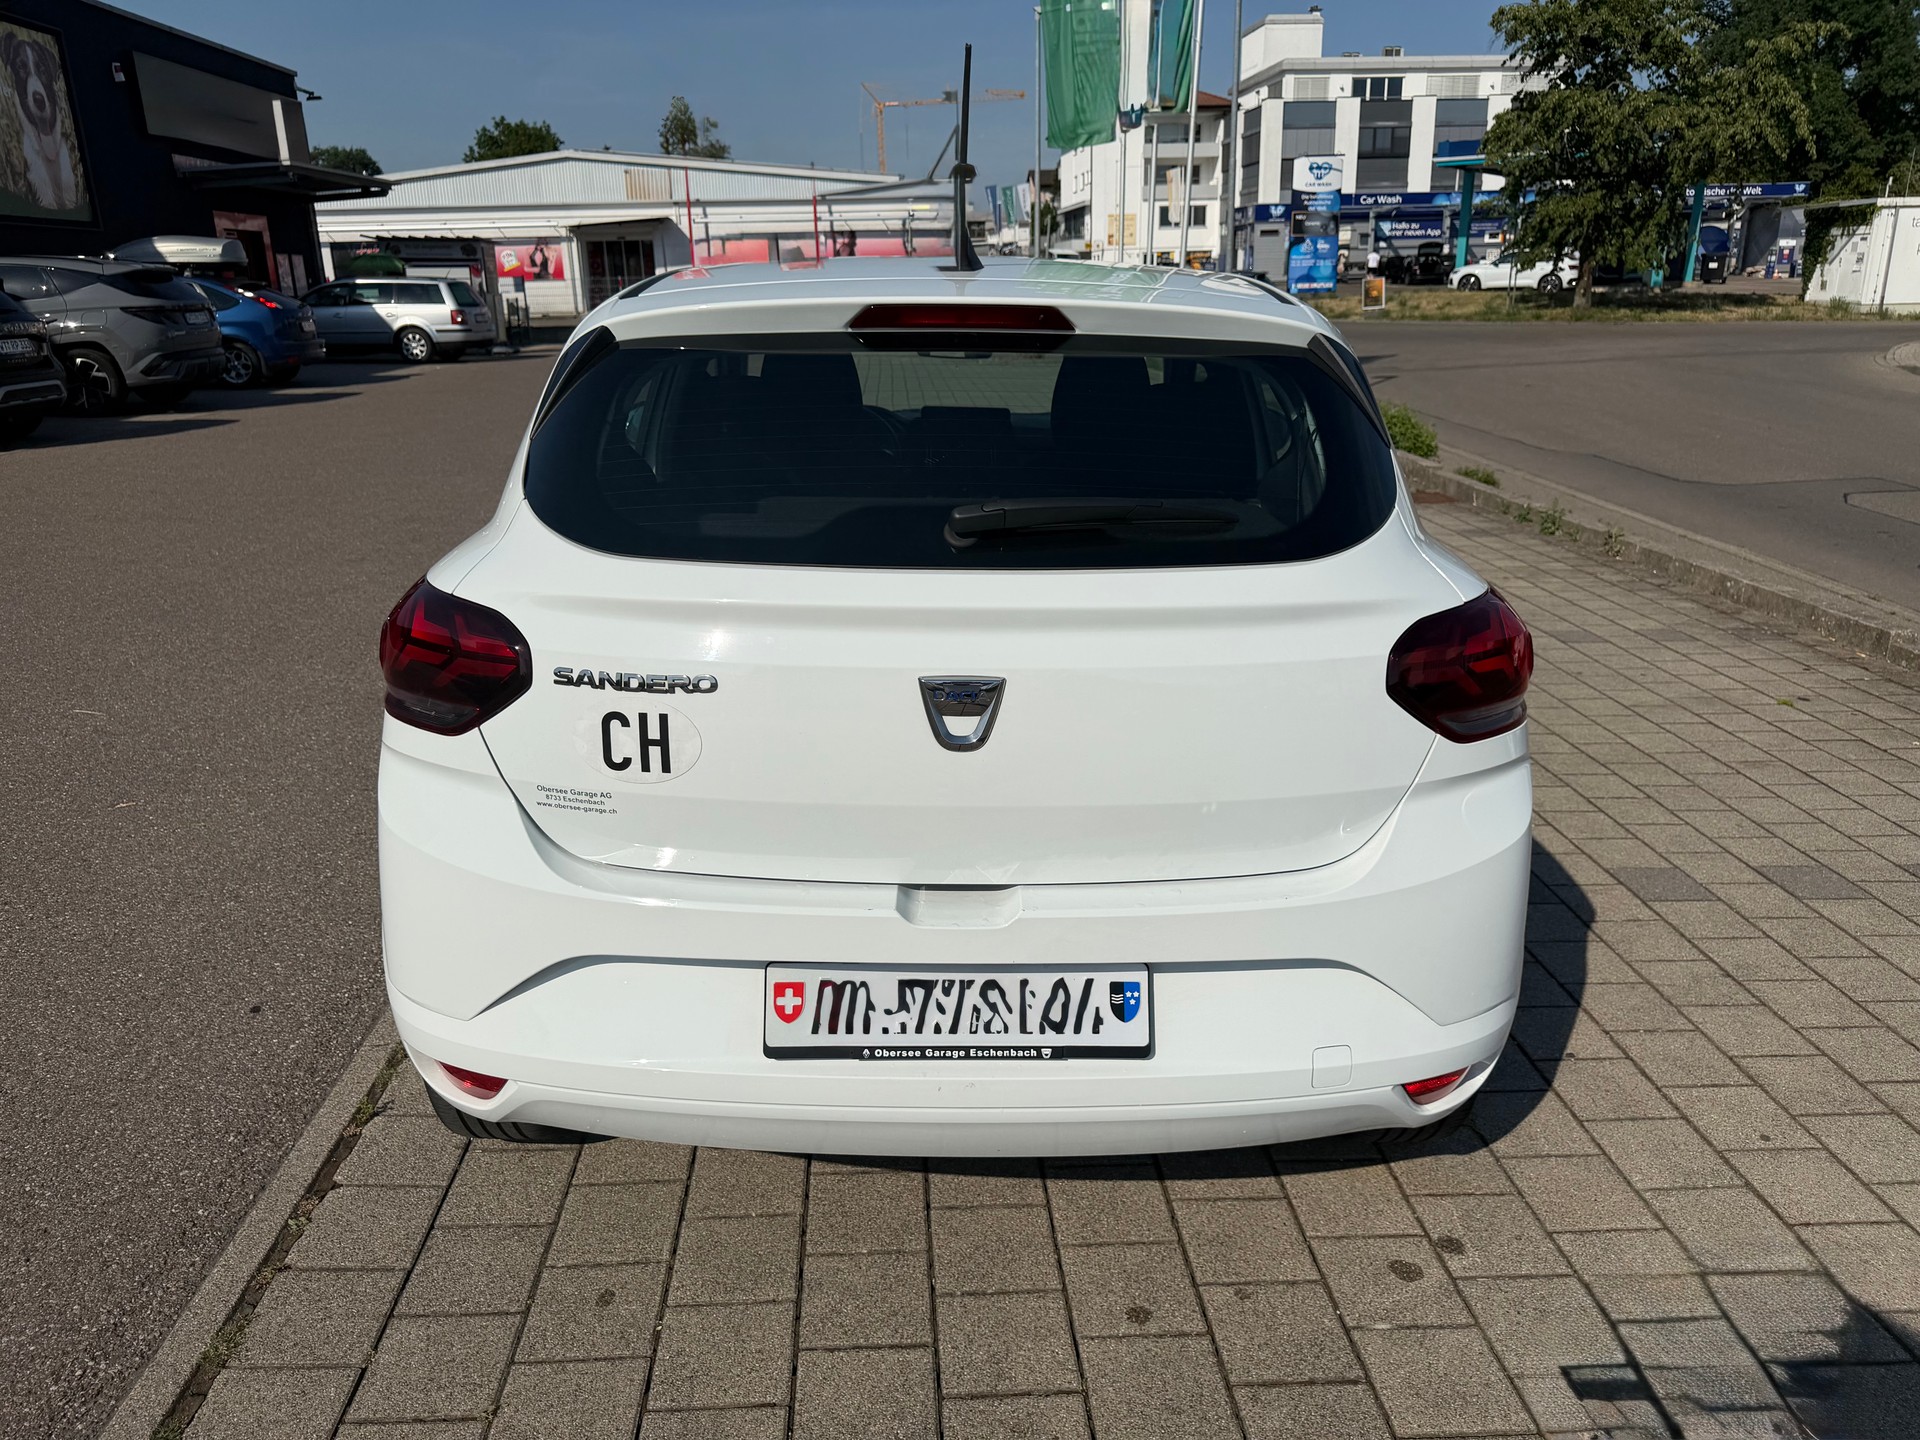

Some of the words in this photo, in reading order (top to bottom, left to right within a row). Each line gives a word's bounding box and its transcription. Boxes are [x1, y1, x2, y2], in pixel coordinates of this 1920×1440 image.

[1743, 186, 1762, 195] Welt
[1360, 195, 1375, 205] Car
[1376, 194, 1403, 205] Wash
[553, 666, 719, 694] SANDERO
[933, 690, 989, 701] DACIA
[601, 711, 671, 774] CH
[536, 784, 568, 795] Obersee
[570, 788, 598, 798] Garage
[599, 791, 612, 799] AG
[562, 796, 605, 806] Eschenbach
[536, 801, 618, 814] www.obersee-garage.ch
[874, 1049, 921, 1057] Obersee
[925, 1049, 965, 1059] Garage
[969, 1049, 1037, 1057] Eschenbach
